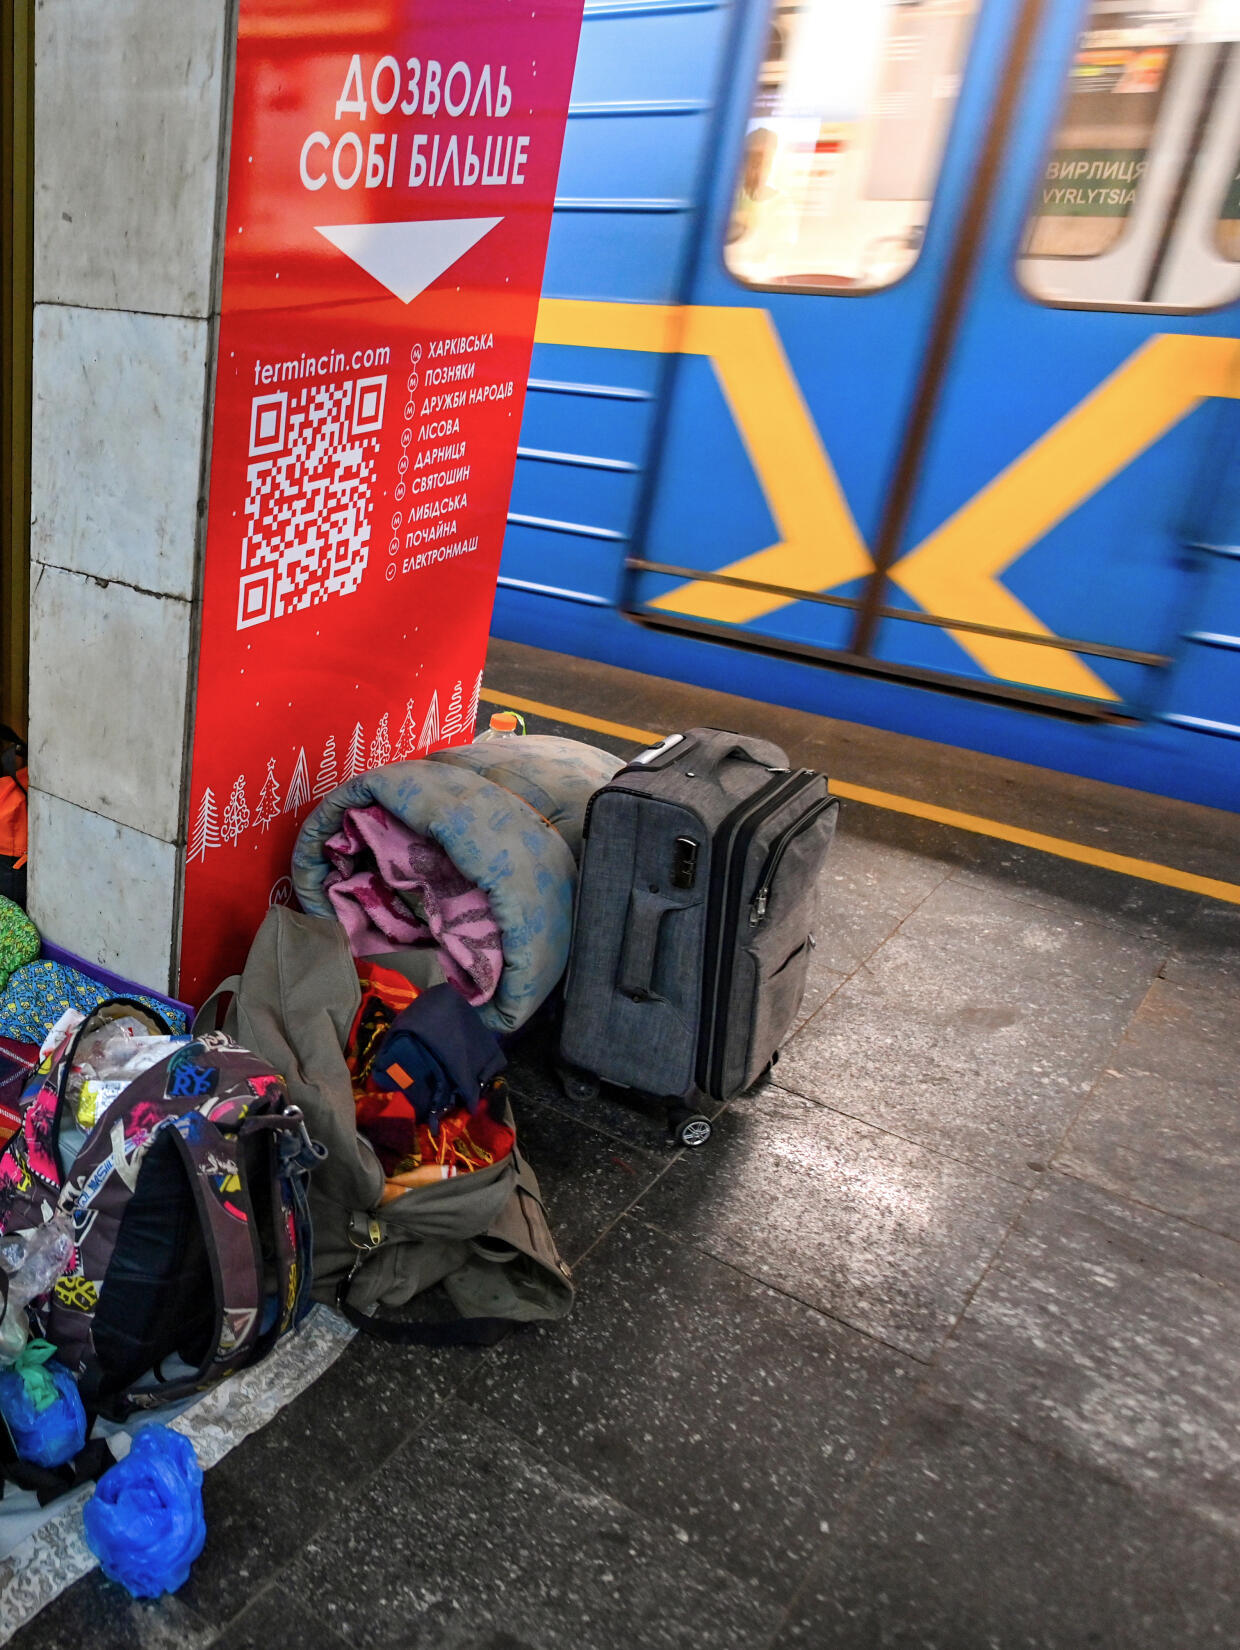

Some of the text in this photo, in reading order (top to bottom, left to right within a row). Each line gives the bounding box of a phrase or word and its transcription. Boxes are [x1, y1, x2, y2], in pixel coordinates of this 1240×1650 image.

[335, 54, 513, 121] ДОЗВОЛЬ
[299, 131, 530, 191] СОБІ БІЛЬШЕ
[427, 333, 494, 359] ХАРКІВСЬКА
[254, 347, 391, 386] termincin.com
[425, 362, 476, 387] ПОЗНЯКИ
[420, 390, 468, 417] ДРУЖБИ
[467, 381, 514, 405] НАРОДІВ
[417, 417, 460, 442] ЛІСОВА
[413, 441, 466, 471] ДАРНИЦЯ
[412, 465, 471, 494] СВЯТОШИН
[407, 492, 468, 524] ЛИБІДСЬКА
[405, 519, 457, 549] ПОЧАЙНА
[402, 535, 479, 574] ЕЛЕКТРОНМАШ
